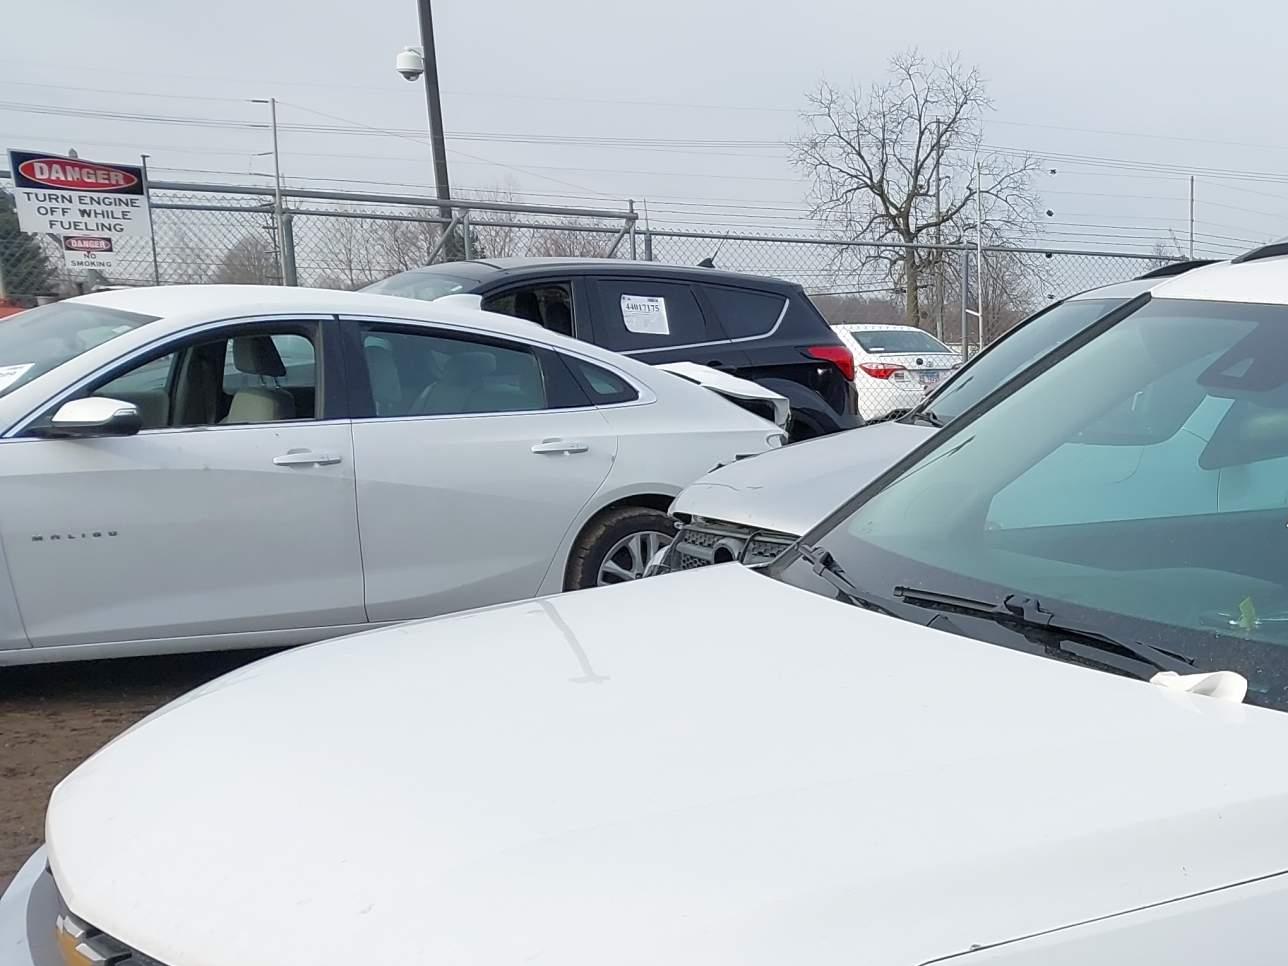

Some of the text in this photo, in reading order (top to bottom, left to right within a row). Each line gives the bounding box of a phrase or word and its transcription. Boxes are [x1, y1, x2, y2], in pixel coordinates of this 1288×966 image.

[33, 162, 125, 185] DANGER
[23, 192, 140, 207] TURN ENGINE
[37, 206, 133, 220] OFF WHILE
[49, 220, 125, 233] FUELING
[71, 239, 106, 249] DANGER
[31, 531, 118, 541] MALIBU
